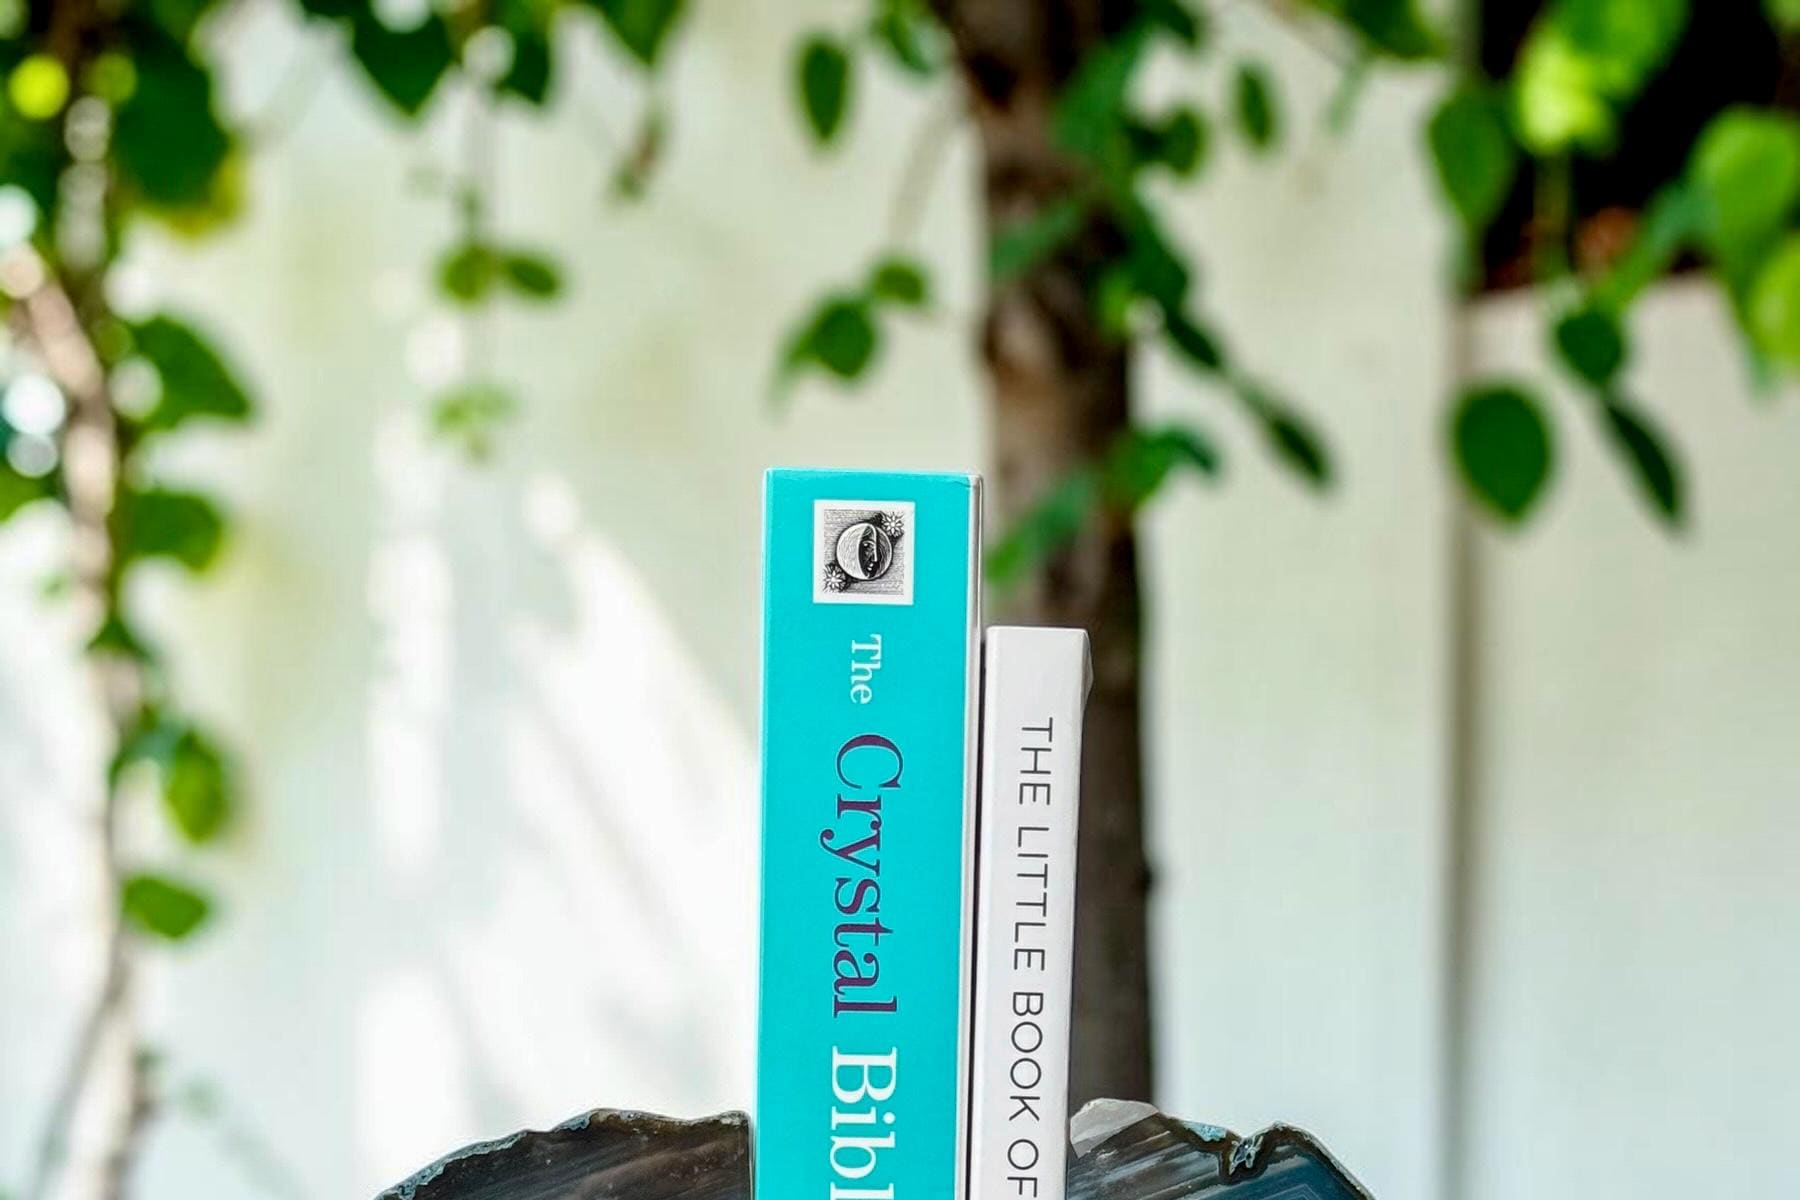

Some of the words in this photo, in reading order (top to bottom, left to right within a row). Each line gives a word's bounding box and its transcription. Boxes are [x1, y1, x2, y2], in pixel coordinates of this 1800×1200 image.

[850, 633, 882, 705] The
[1019, 717, 1054, 807] THE
[819, 734, 904, 1018] Crystal
[1013, 826, 1050, 972] LITTLE
[1008, 991, 1044, 1123] BOOK
[1006, 1138, 1040, 1199] OF
